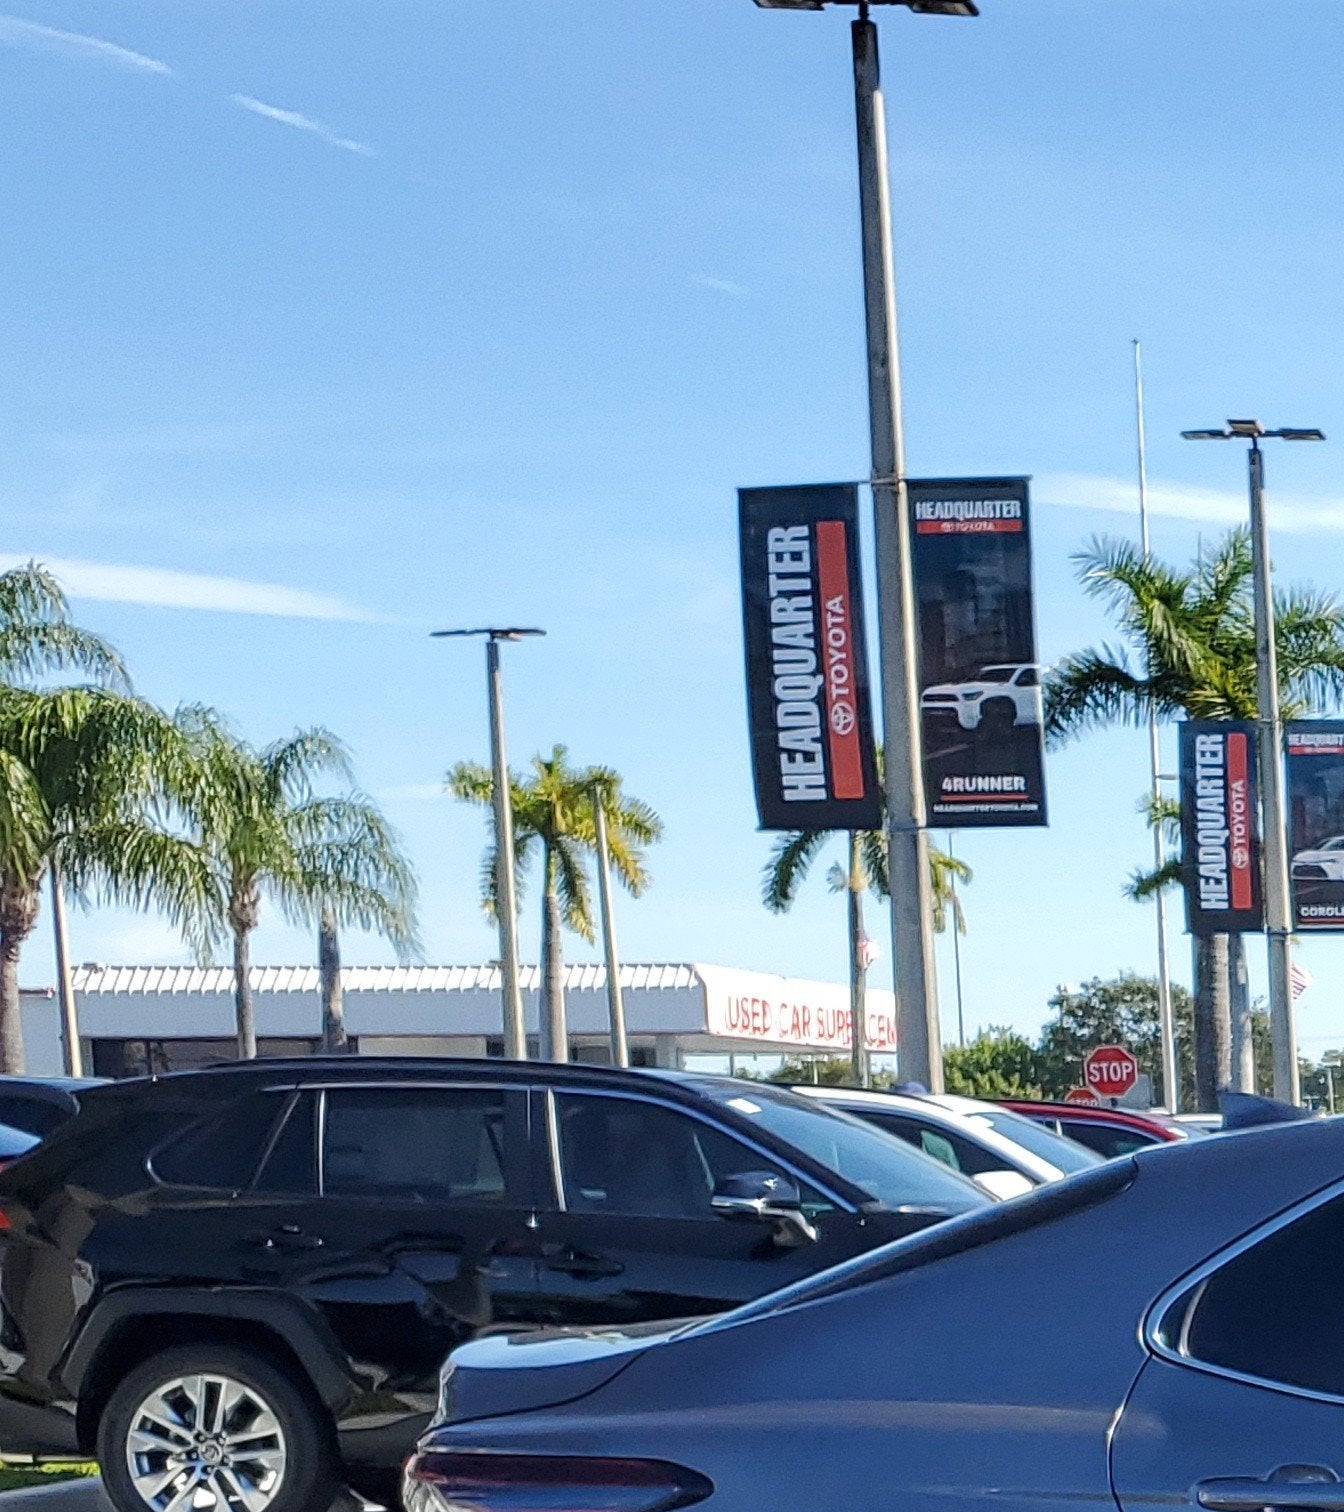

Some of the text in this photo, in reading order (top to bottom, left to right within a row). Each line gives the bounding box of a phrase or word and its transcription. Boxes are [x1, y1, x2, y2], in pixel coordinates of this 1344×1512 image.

[916, 500, 1021, 520] HEADQUARTER
[767, 524, 828, 801] HEADQUARTER
[825, 595, 851, 699] TOYOTA
[942, 776, 1026, 792] 4RUNNER
[1195, 733, 1229, 910] HEADQUARTER
[1232, 780, 1248, 849] TOYOTA
[727, 996, 772, 1035] USED
[778, 1003, 811, 1040] CAR
[1089, 1062, 1133, 1082] STOP
